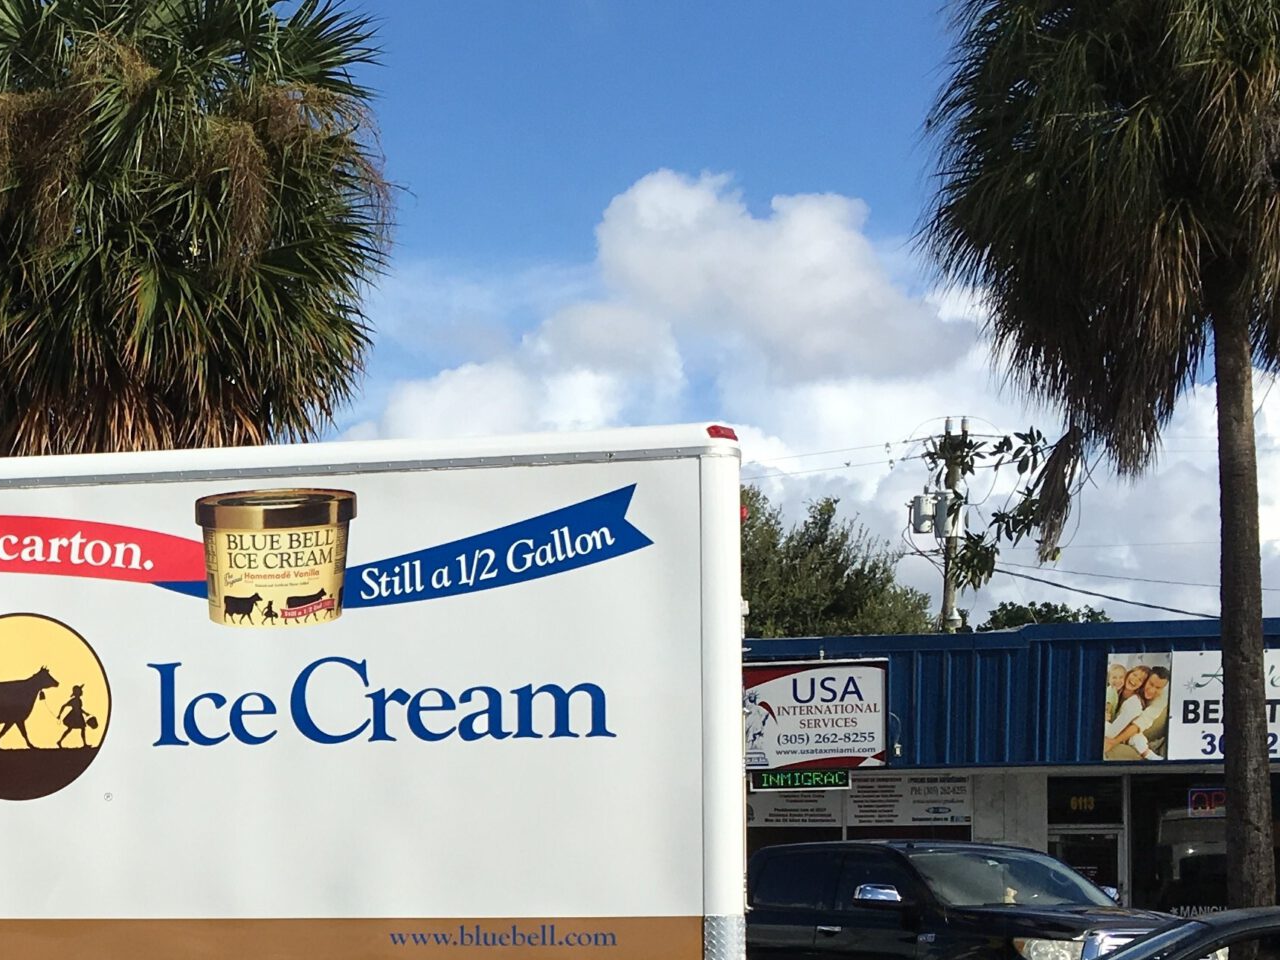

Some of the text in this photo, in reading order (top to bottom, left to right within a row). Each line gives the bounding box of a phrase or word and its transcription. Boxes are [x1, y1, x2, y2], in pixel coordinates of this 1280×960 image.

[226, 533, 281, 551] BLUE
[288, 529, 333, 549] BELL
[228, 547, 333, 570] ICE CREAM
[360, 526, 615, 600] Still a 1/2 Gallon
[293, 568, 320, 577] Vanilla
[792, 676, 865, 704] USA
[147, 661, 279, 747] Ice
[290, 656, 617, 745] Cream
[777, 703, 880, 717] INTERNATIONAL
[799, 717, 858, 729] SERVICES
[777, 731, 876, 746] (305) 262-8255
[776, 747, 876, 756] www.usataxmiami.com
[761, 771, 847, 787] INMIGRAC
[389, 924, 618, 947] www.bluebell.com
